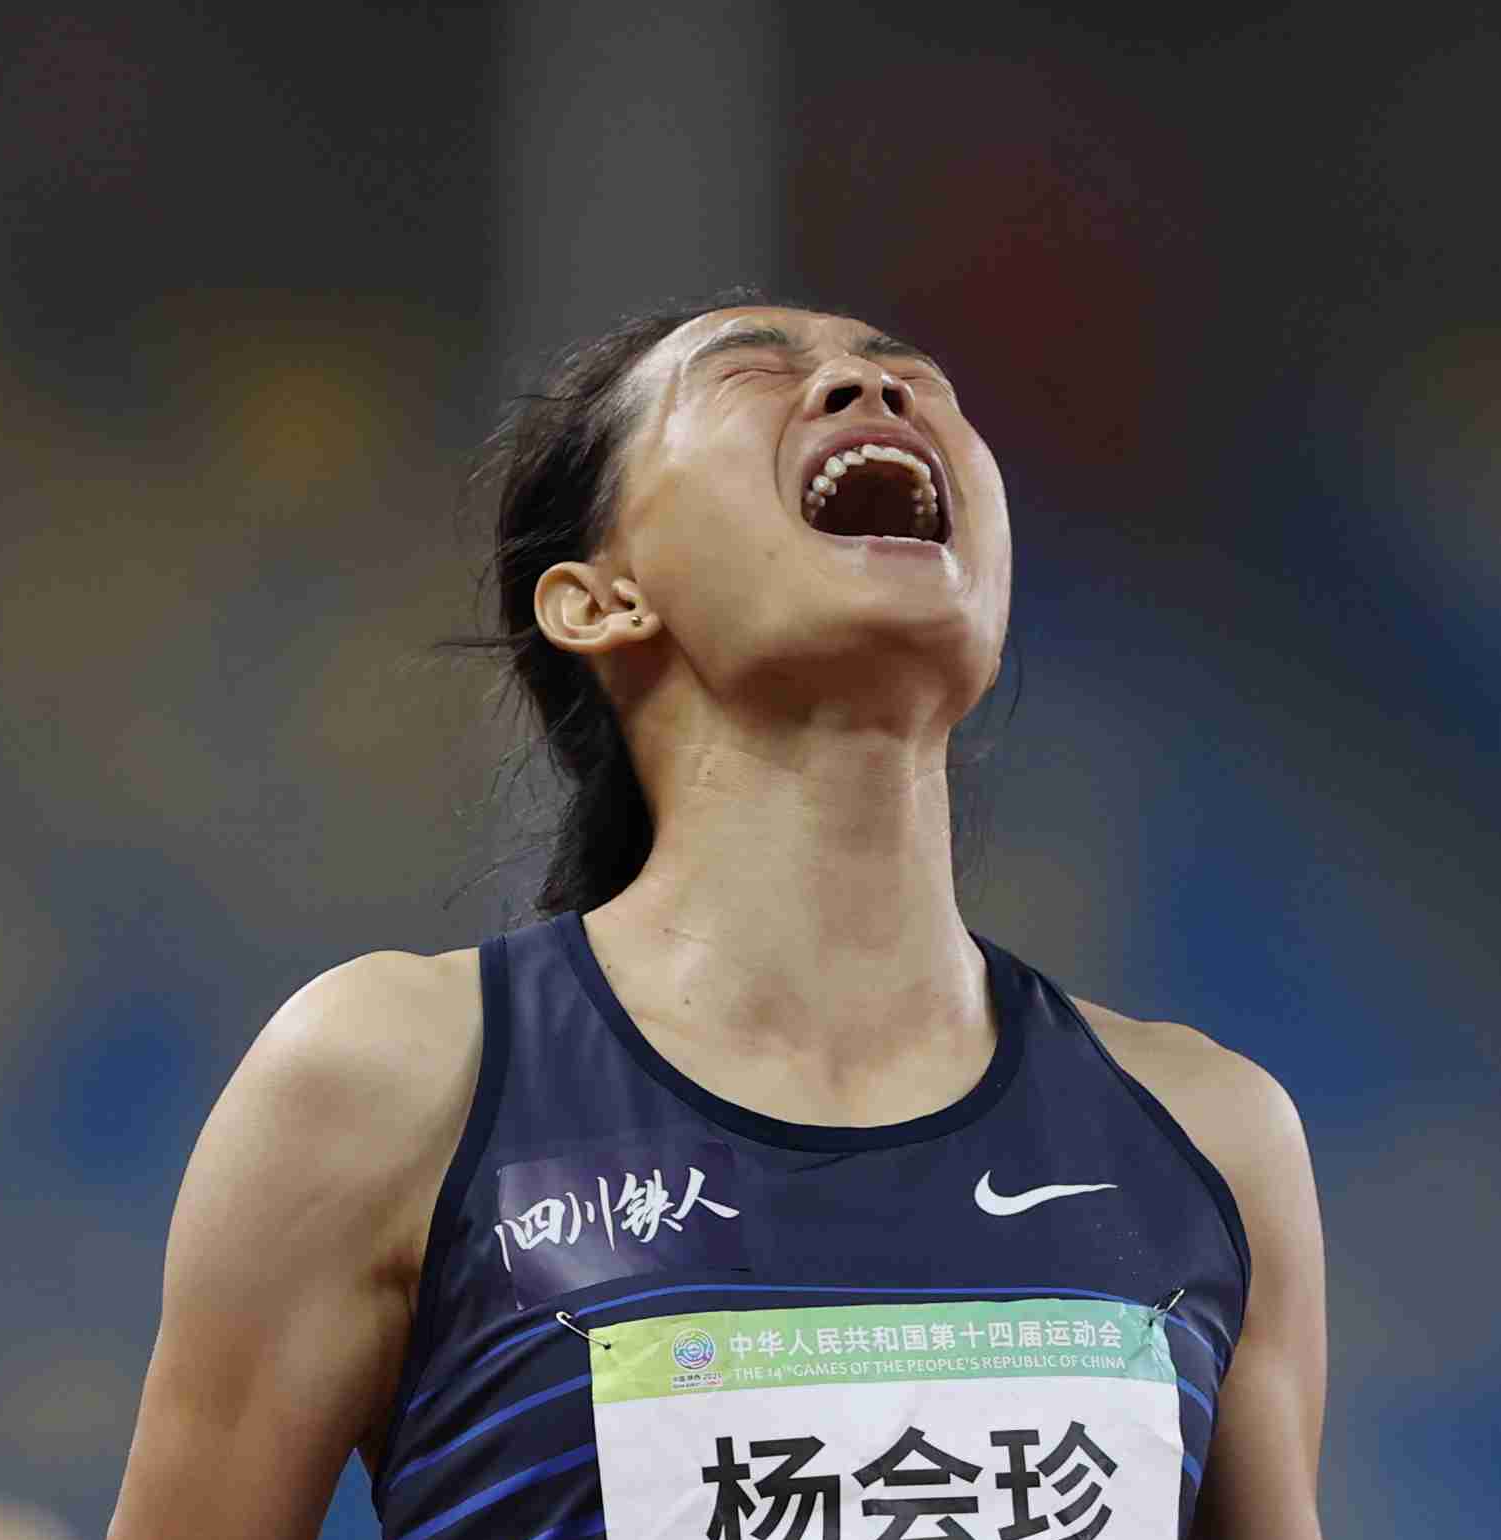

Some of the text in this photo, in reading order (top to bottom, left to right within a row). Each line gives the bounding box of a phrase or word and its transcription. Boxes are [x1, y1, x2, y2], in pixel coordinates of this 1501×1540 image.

[493, 1166, 740, 1273] 四川铁人
[729, 1320, 1124, 1360] 中华人民共和国第十四届运动会
[731, 1367, 763, 1381] THE
[793, 1362, 848, 1377] GAMES
[850, 1361, 870, 1375] OF
[872, 1359, 905, 1374] THE
[906, 1357, 980, 1373] PEOPLE'S
[982, 1354, 1057, 1369] REPUBLIC
[1059, 1354, 1076, 1368] OF
[1082, 1354, 1125, 1369] CHINA
